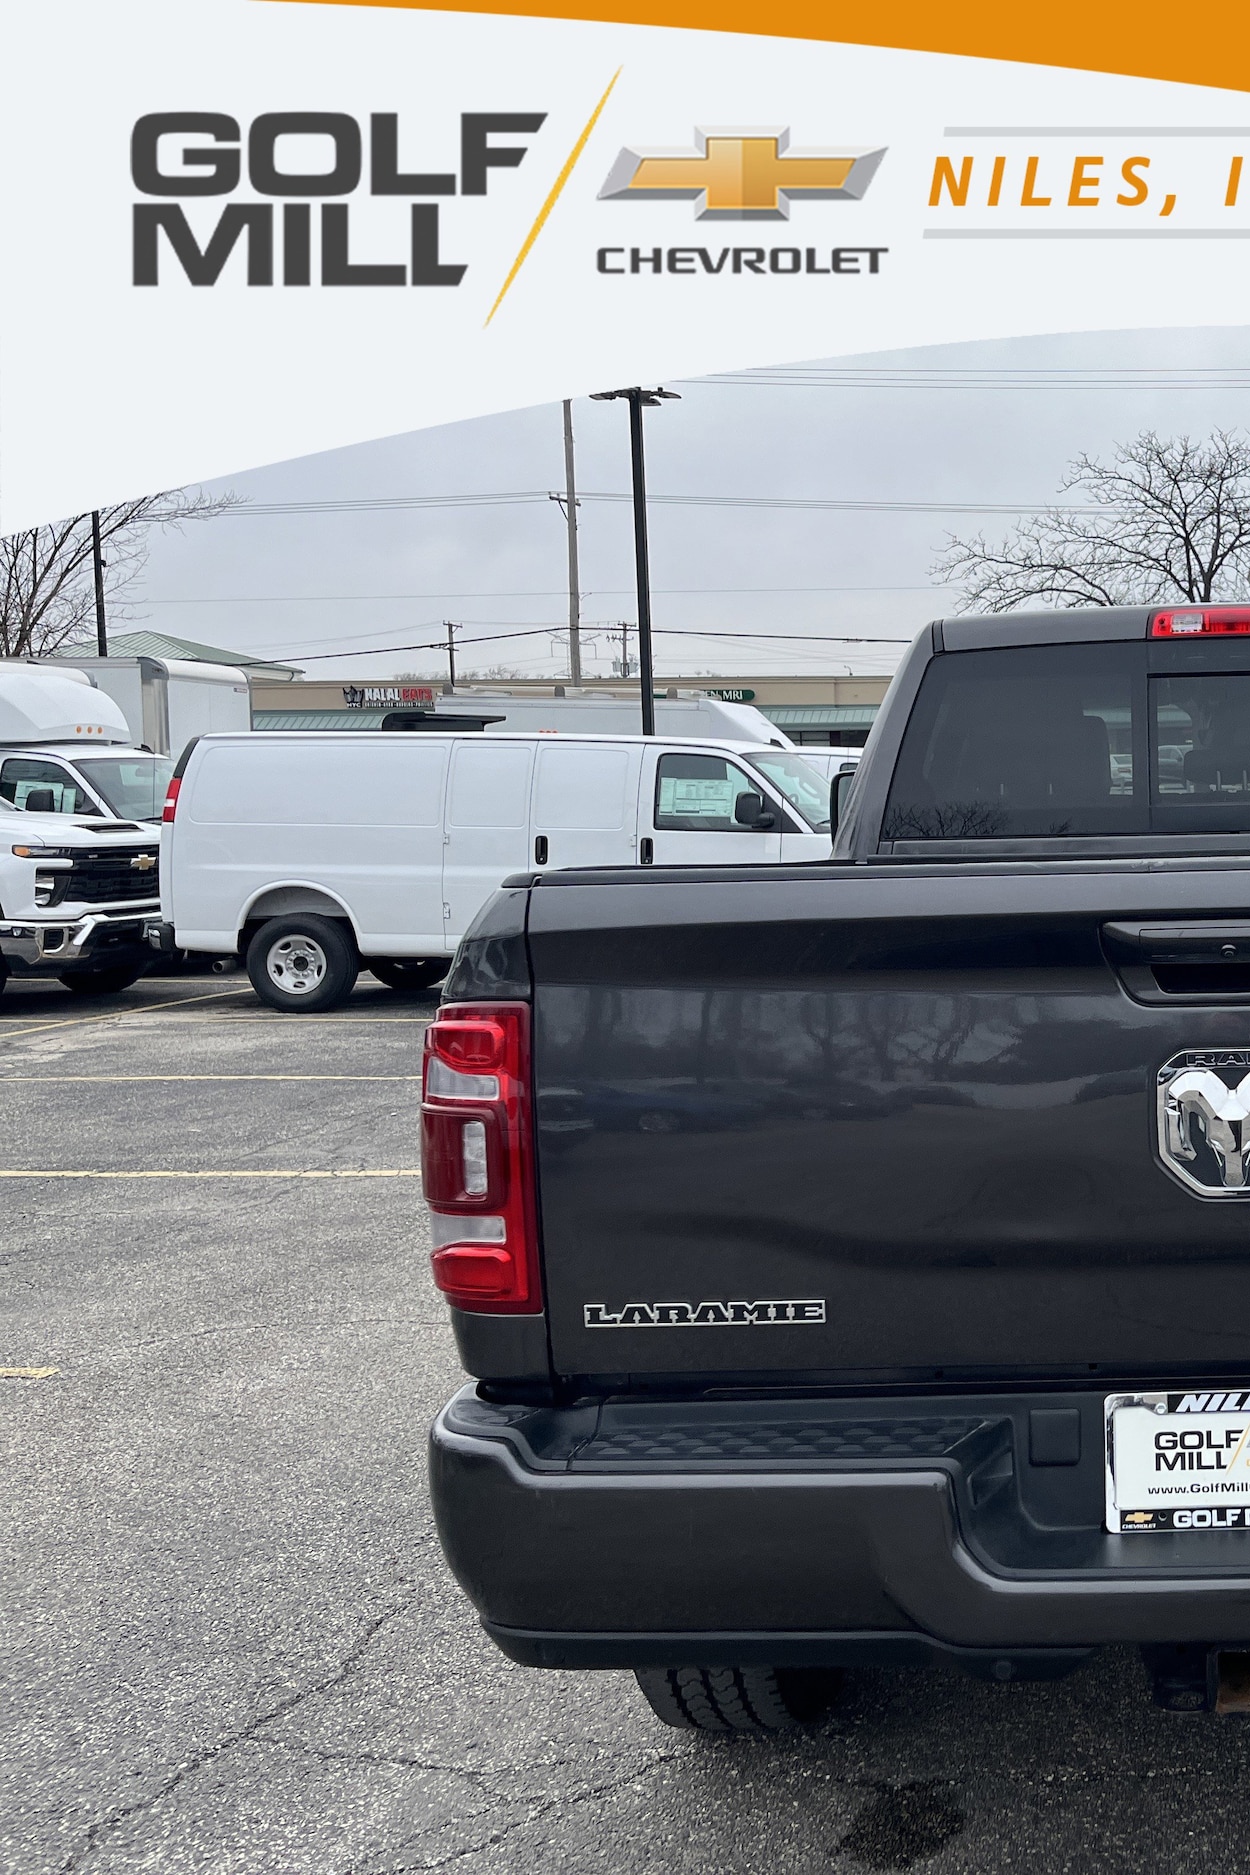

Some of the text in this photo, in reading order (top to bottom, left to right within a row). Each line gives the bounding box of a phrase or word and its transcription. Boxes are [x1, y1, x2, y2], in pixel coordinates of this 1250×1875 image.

[364, 687, 433, 702] HALAL EATS
[722, 690, 743, 700] MRI
[584, 1300, 826, 1328] LARAMIE
[1154, 1429, 1244, 1450] GOLF
[1155, 1451, 1228, 1471] MILL
[1173, 1508, 1241, 1528] GOLF
